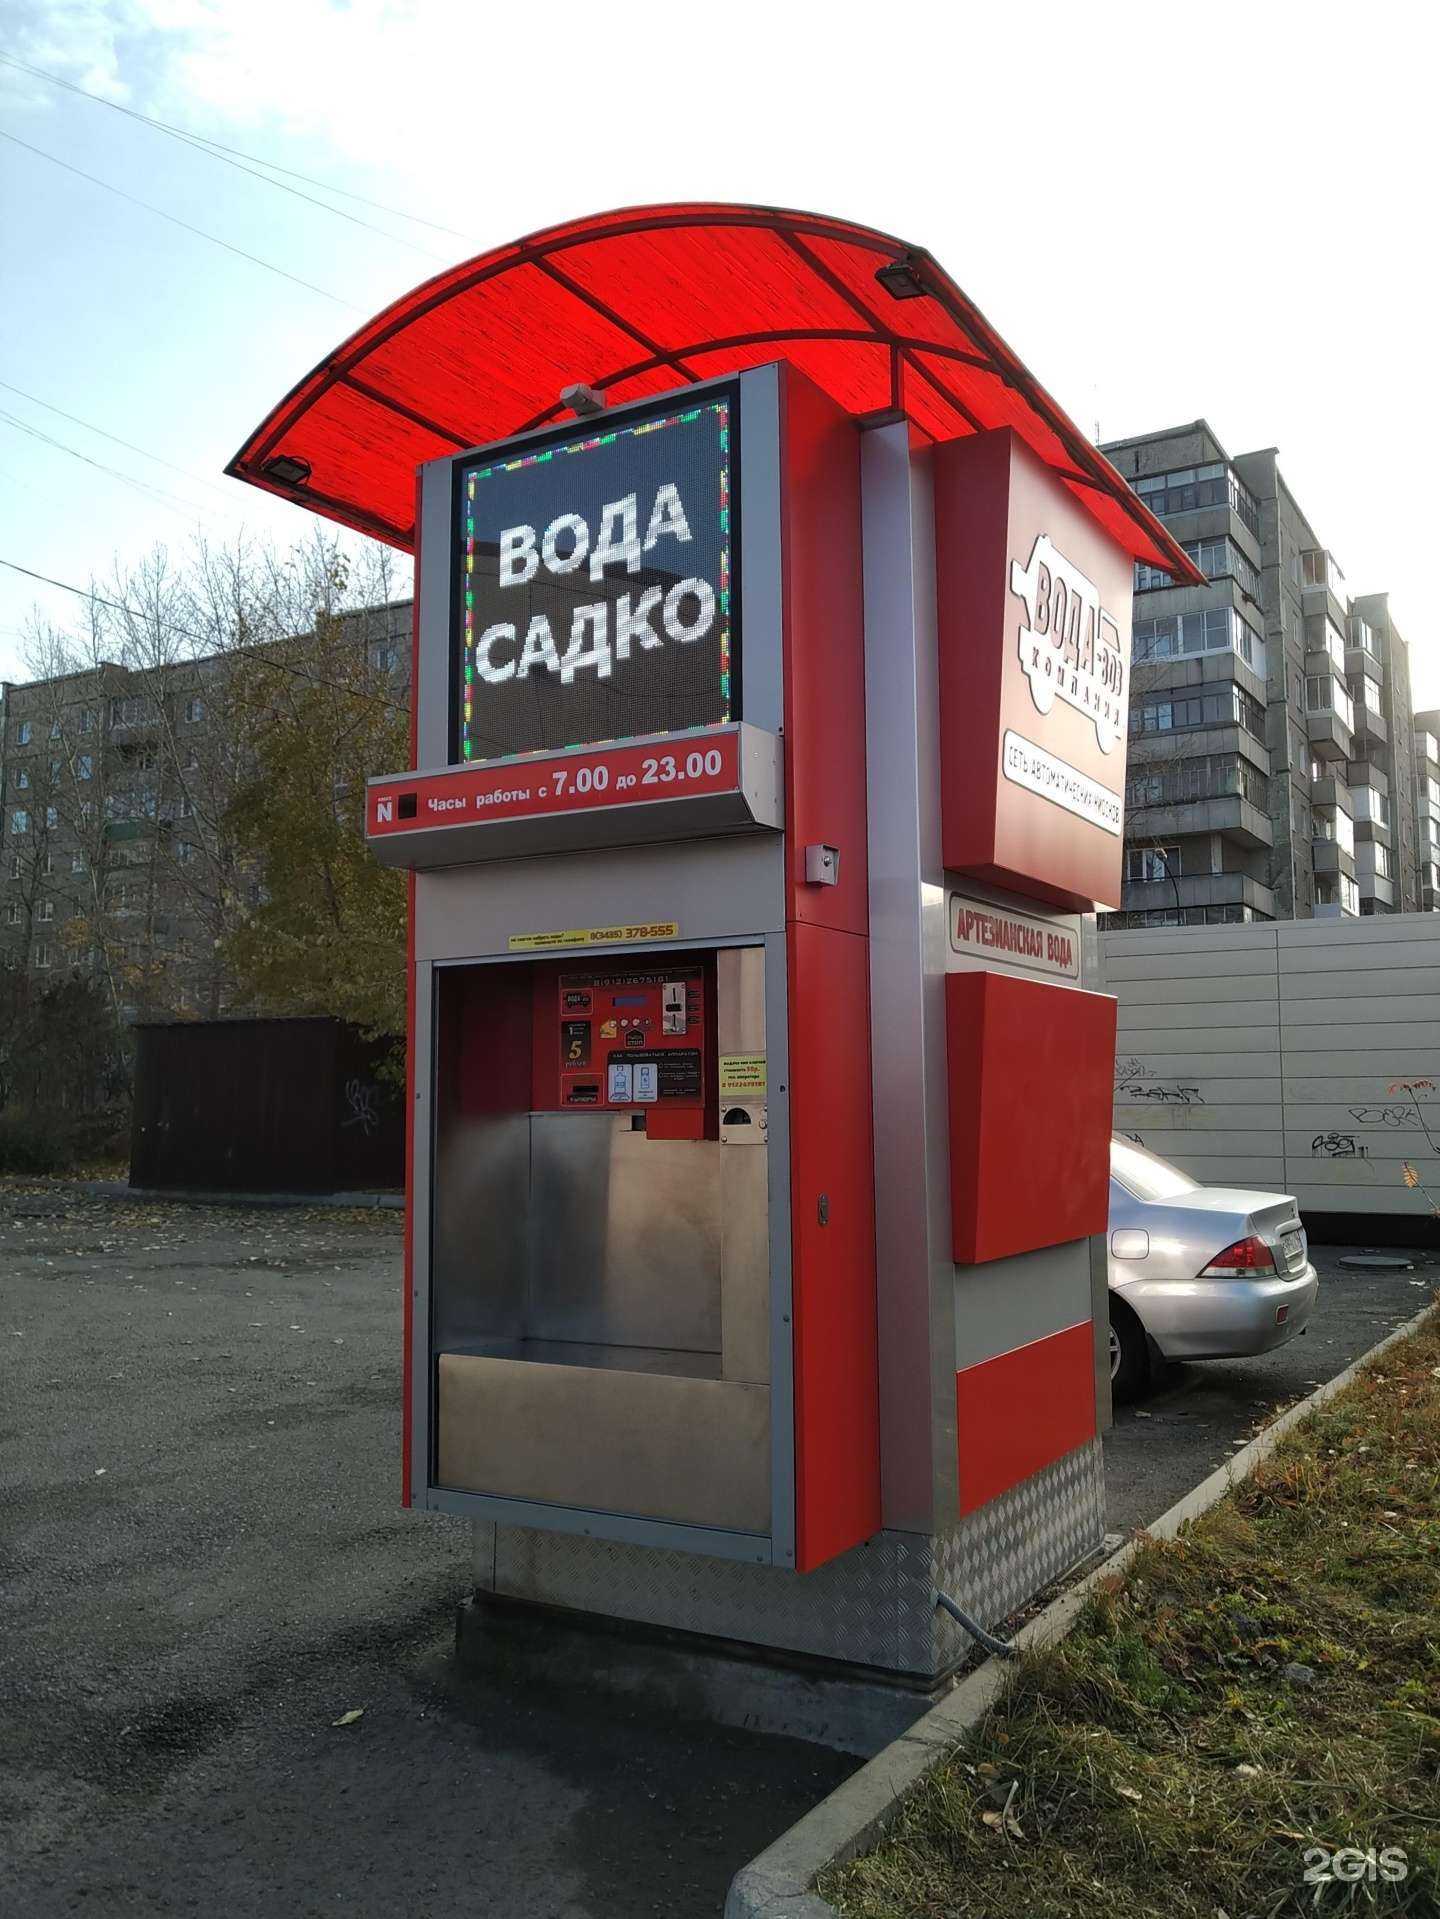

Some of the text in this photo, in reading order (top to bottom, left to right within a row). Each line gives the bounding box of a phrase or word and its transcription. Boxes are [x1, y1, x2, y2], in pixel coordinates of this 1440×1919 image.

[499, 482, 693, 588] ВОДА
[475, 577, 716, 684] САДКО
[427, 749, 722, 812] Часы работы с 7.00 до 23.00
[1008, 745, 1029, 768] СЕТЬ
[625, 924, 674, 939] 378-555
[957, 907, 1073, 969] АРТЕЗИАНСКАЯ ВОДА
[568, 1040, 582, 1059] 5
